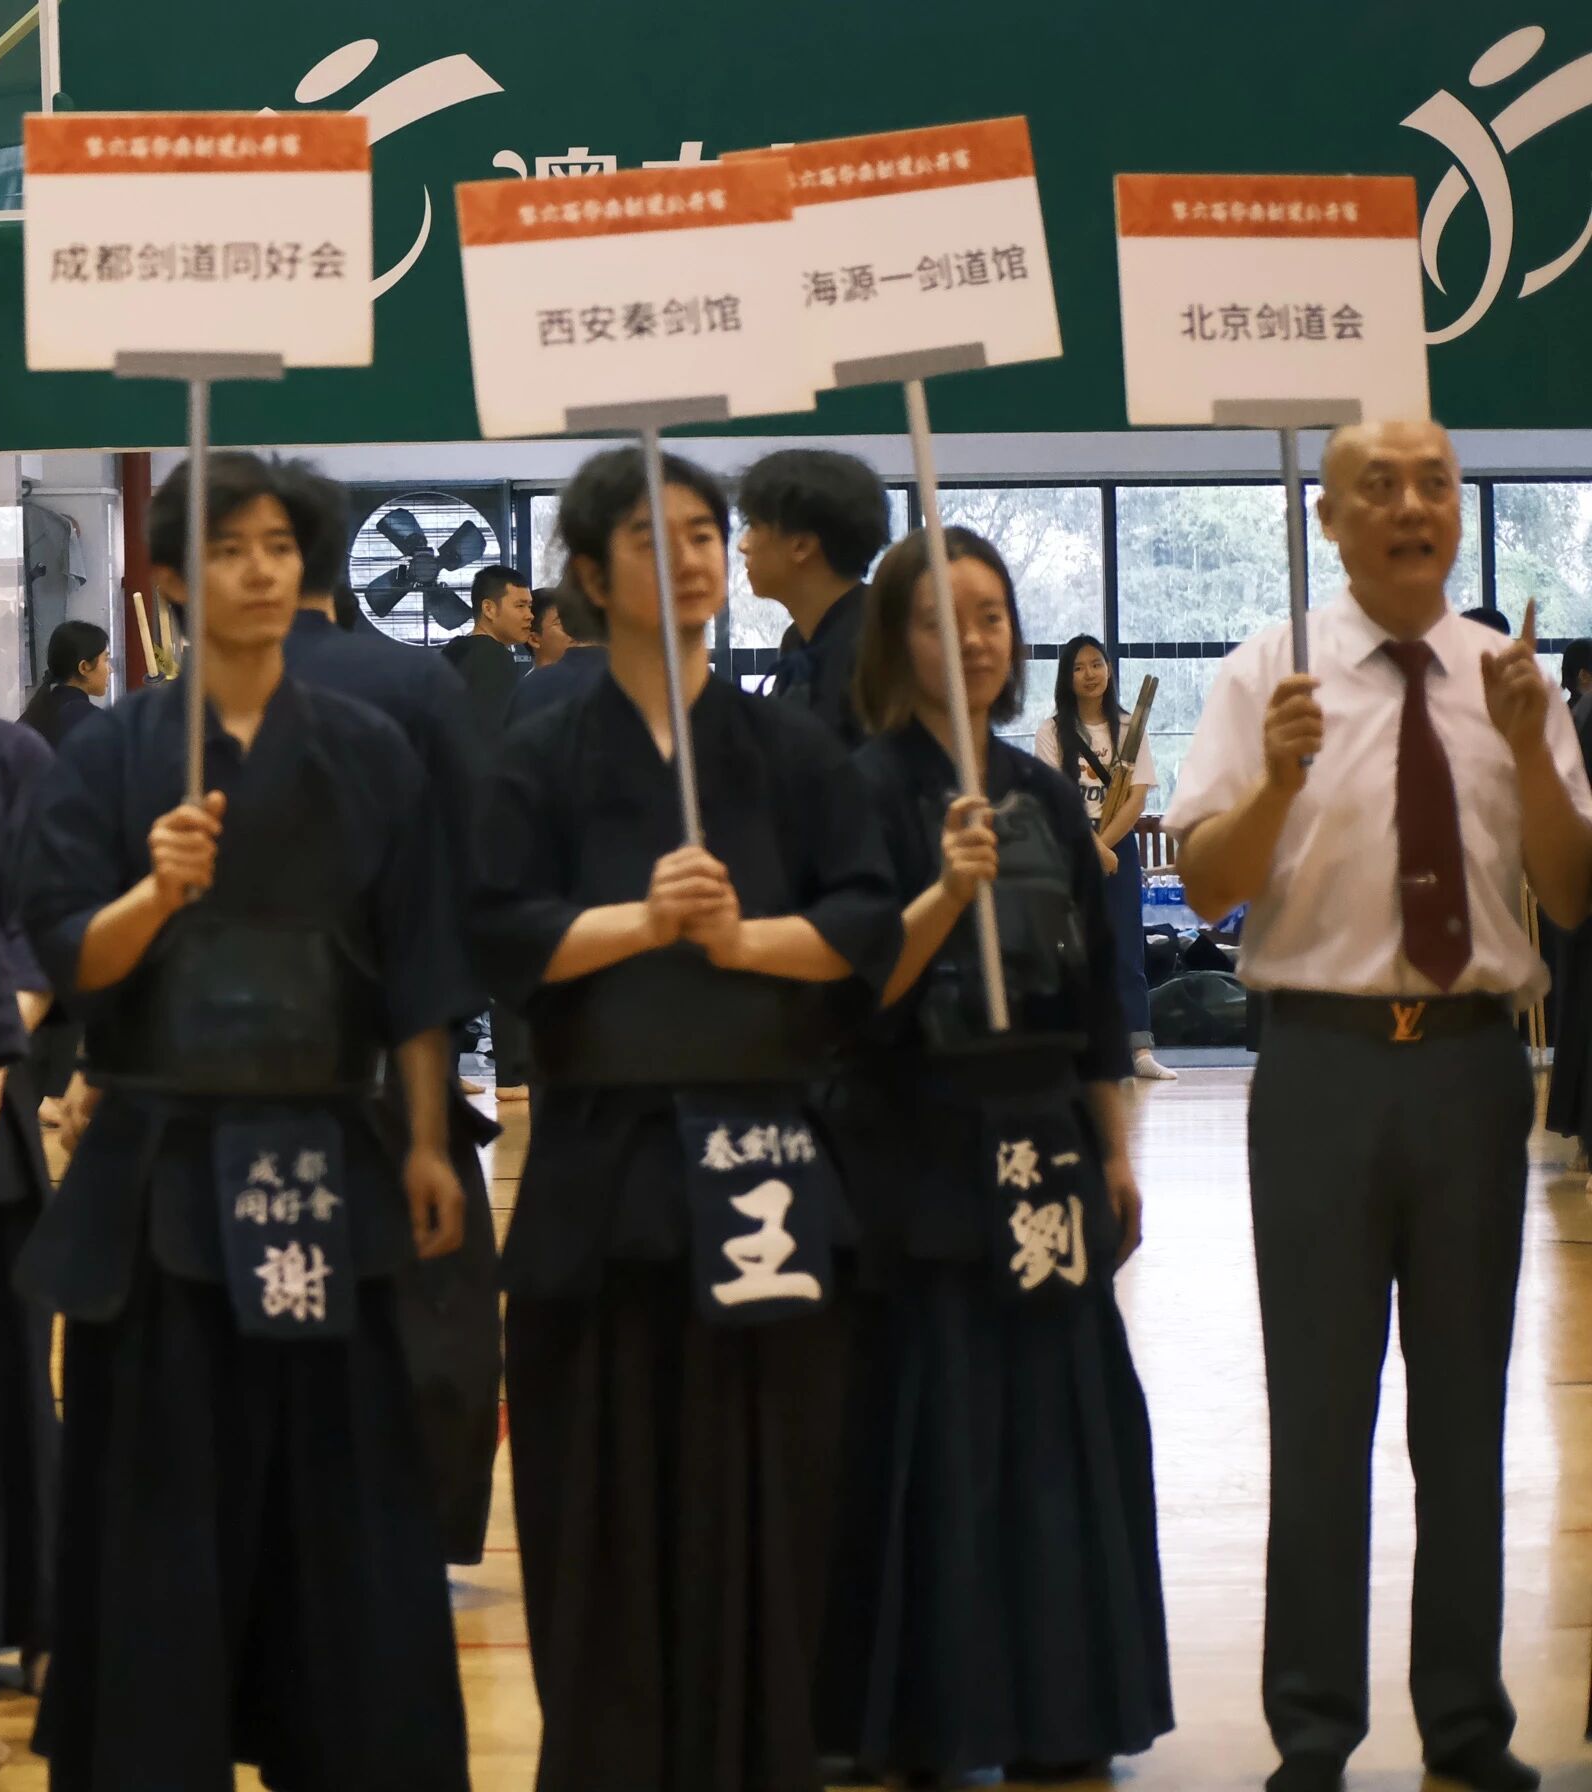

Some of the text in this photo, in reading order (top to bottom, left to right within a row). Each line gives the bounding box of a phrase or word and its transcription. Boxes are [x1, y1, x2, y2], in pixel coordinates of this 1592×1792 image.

[50, 241, 347, 283] 成都剑道同好会
[802, 243, 1029, 308] 海源一剑道馆
[534, 293, 742, 346] 西安秦剑馆
[1179, 303, 1364, 341] 北京剑道会
[710, 1178, 823, 1308] 王
[1008, 1193, 1089, 1290] 劉
[253, 1240, 334, 1321] 謝
